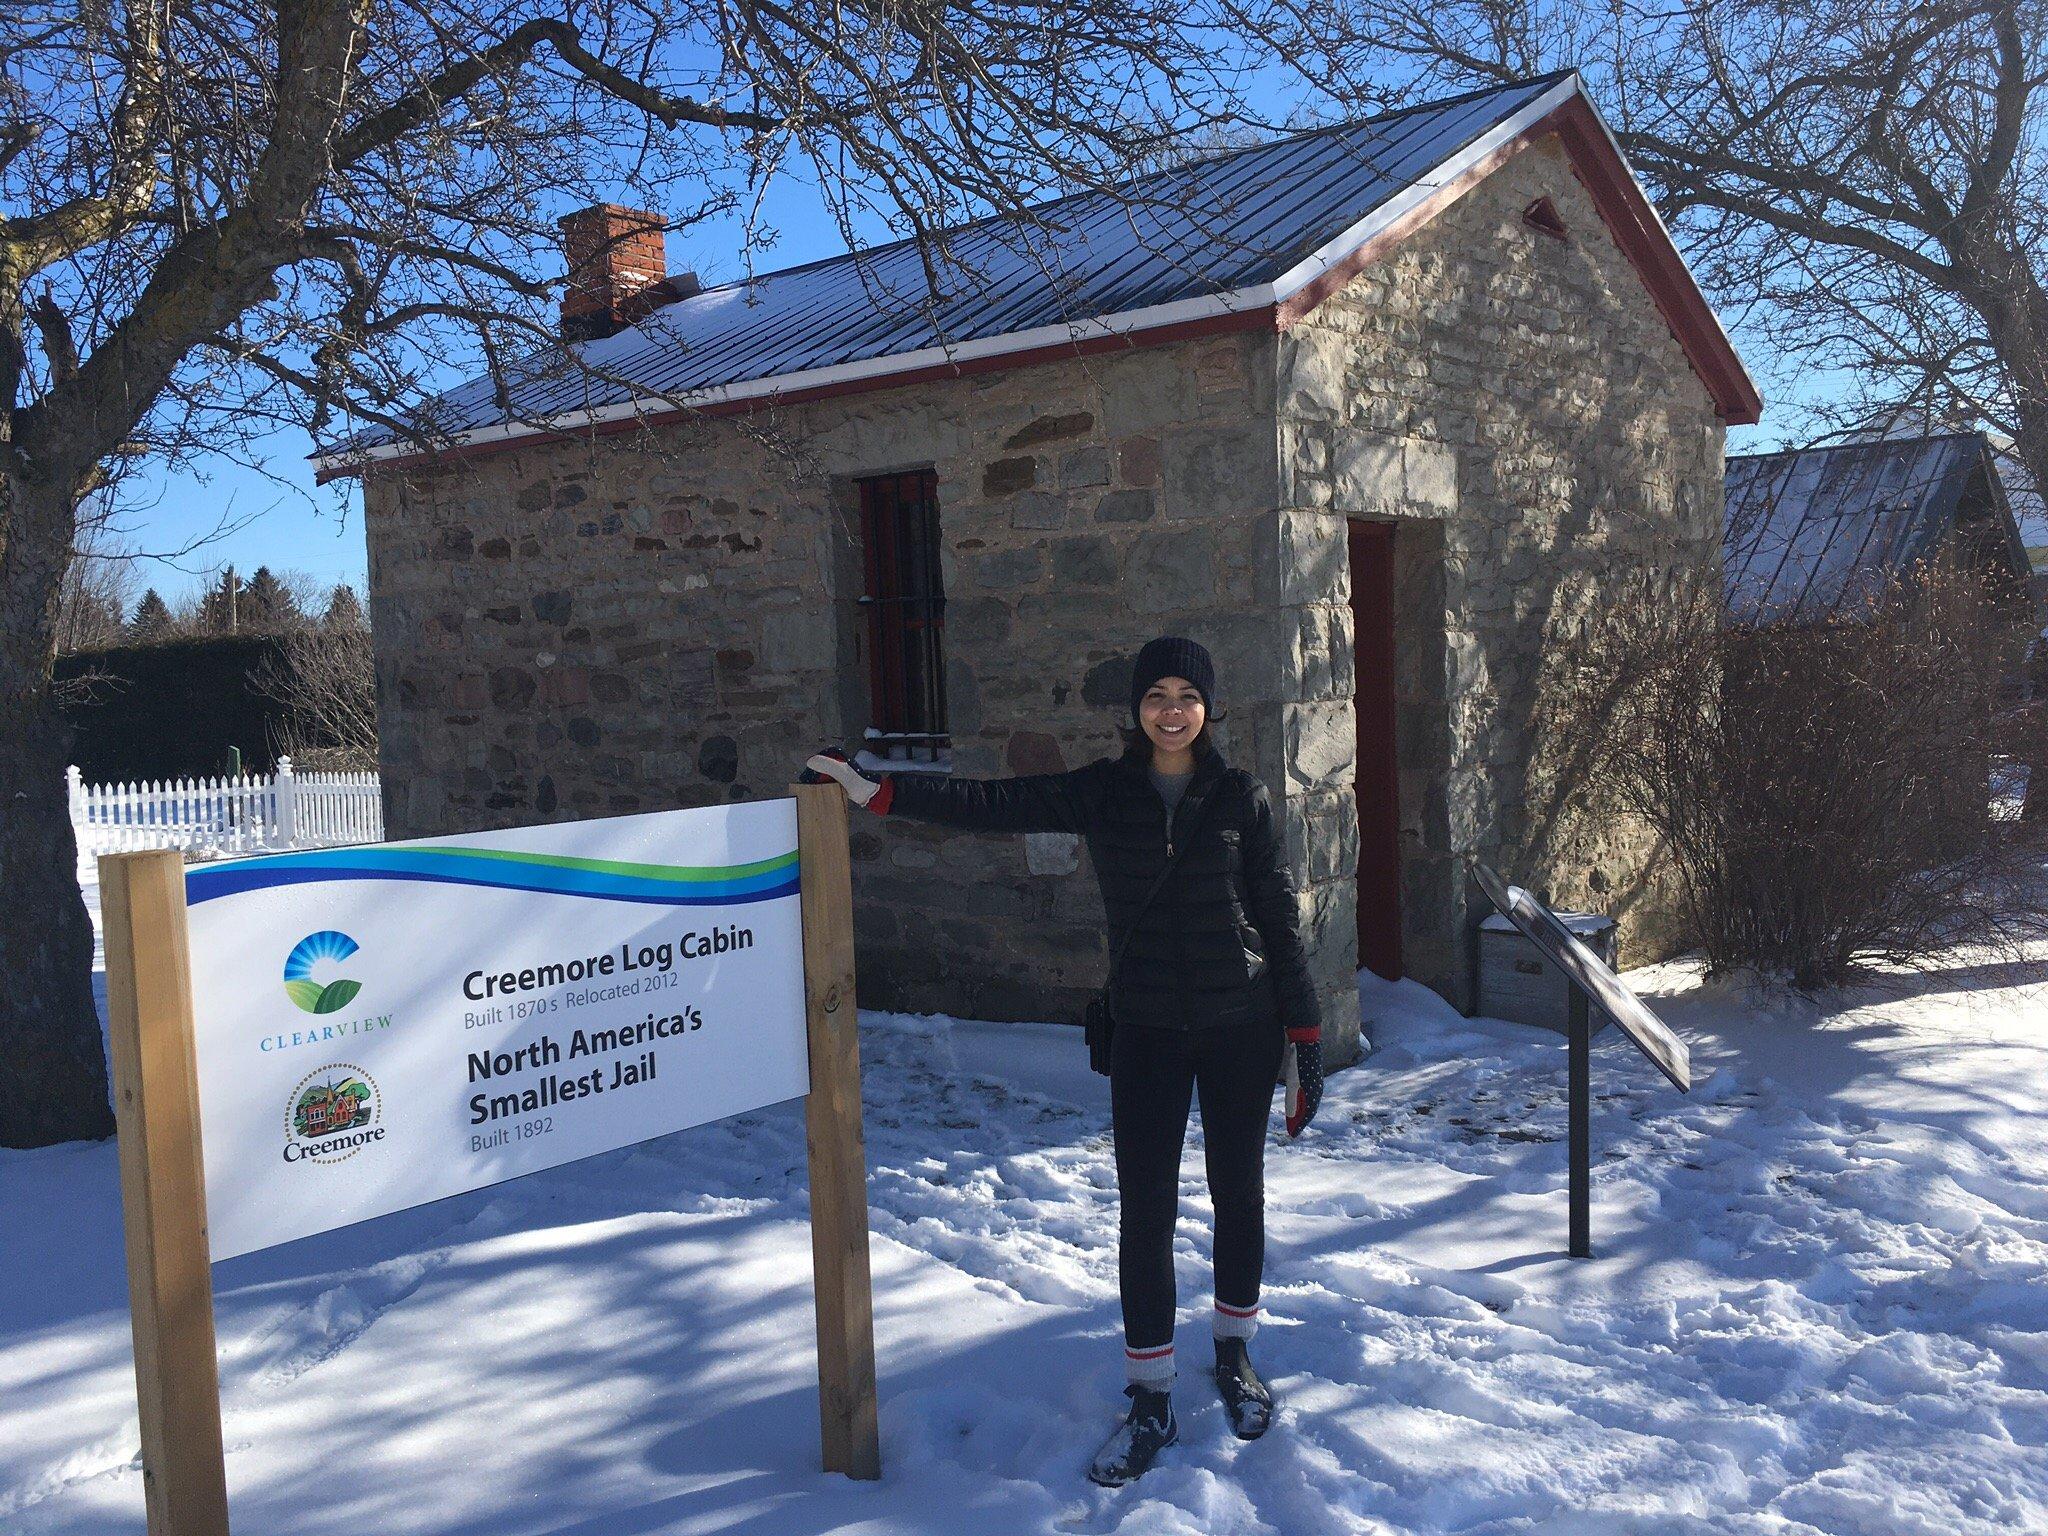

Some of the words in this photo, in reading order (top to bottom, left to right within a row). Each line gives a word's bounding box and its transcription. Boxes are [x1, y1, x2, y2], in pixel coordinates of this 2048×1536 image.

[462, 954, 615, 1001] Creemore
[621, 943, 673, 972] Log
[679, 924, 754, 960] Cabin
[464, 1006, 503, 1030] Built
[566, 977, 640, 1009] Relocated
[643, 971, 678, 993] 2012
[260, 1013, 394, 1053] CLEARVIEW
[467, 1035, 561, 1083] North
[568, 1004, 703, 1060] America's
[469, 1068, 604, 1125] Smallest
[609, 1050, 657, 1091] Jail
[282, 1127, 386, 1163] Creemore
[470, 1128, 510, 1153] Built
[514, 1116, 554, 1141] 1892
